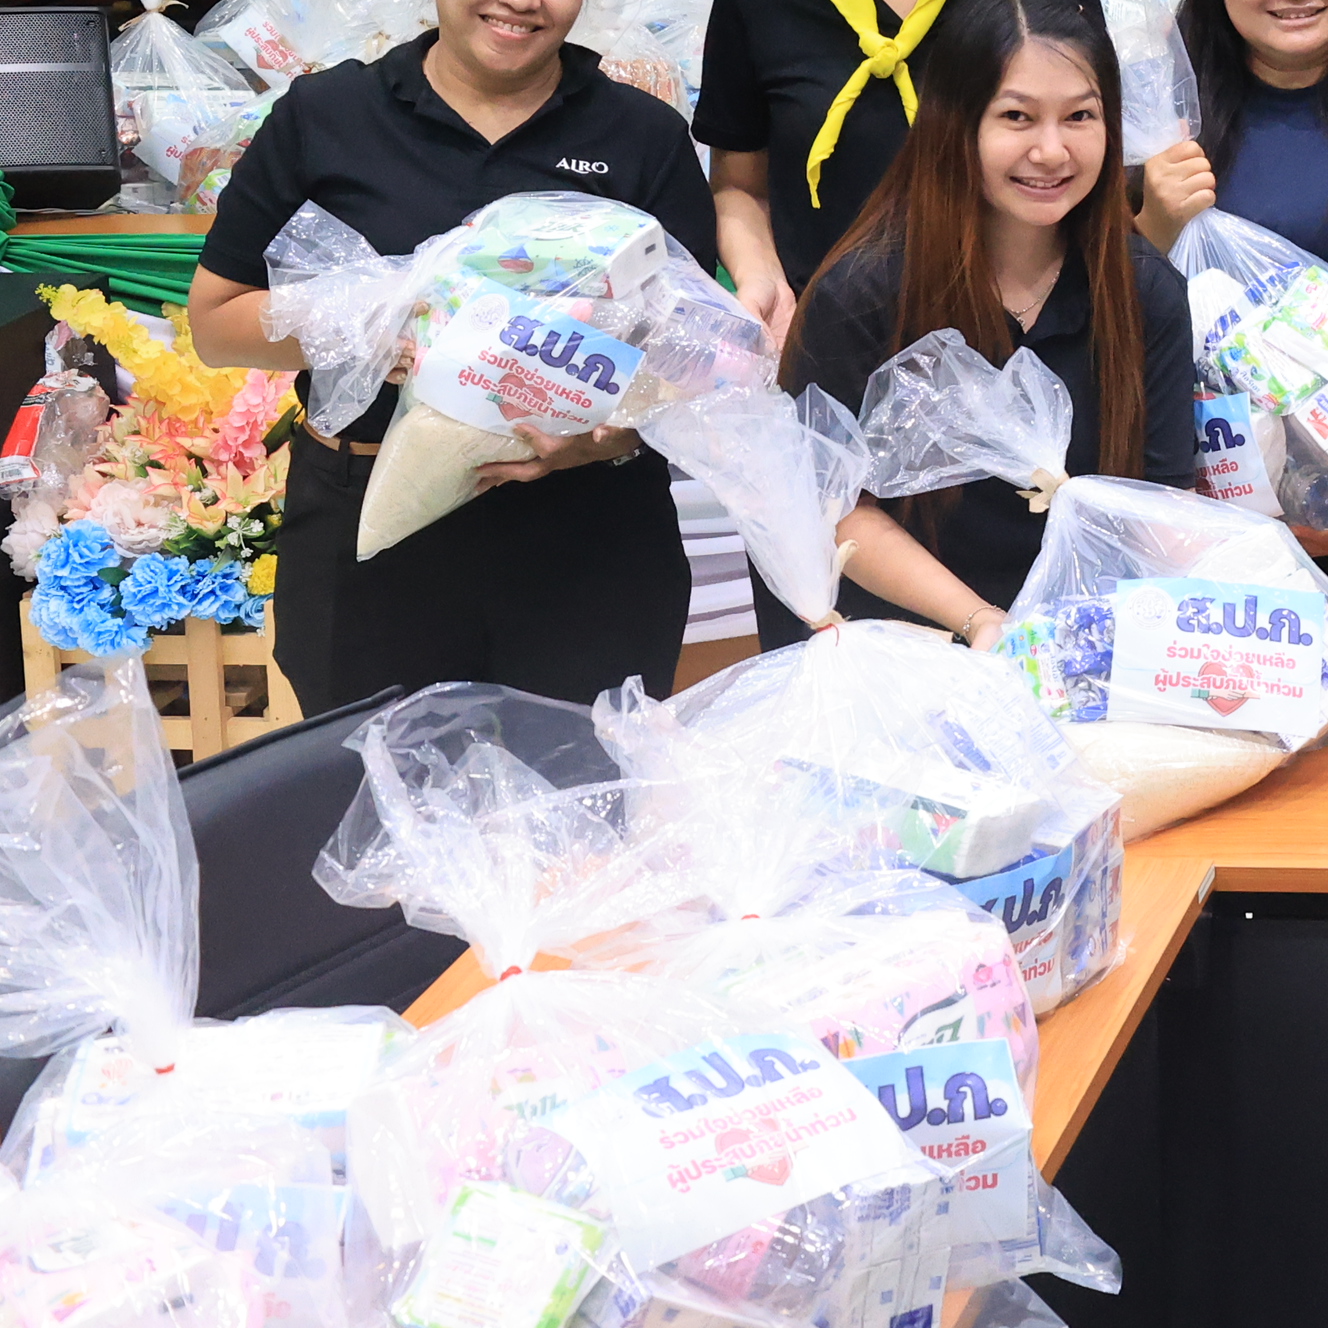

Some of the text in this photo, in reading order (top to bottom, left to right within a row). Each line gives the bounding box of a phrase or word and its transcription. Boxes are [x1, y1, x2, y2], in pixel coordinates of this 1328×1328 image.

[556, 157, 609, 174] ALRO
[478, 348, 593, 409] ร่วมใจช่วยเหลือ
[499, 314, 620, 395] ส.ป.ก.
[458, 367, 590, 424] ผู้ประสบภัยน้ำท่วม
[1176, 595, 1313, 646] ส.ป.ก.
[1166, 641, 1296, 670] ร่วมใจช่วยเหลือ
[1154, 671, 1304, 700] ผู้ประสบภัยน้ำท่วม
[636, 1046, 821, 1118] ส.ป.ก.
[659, 1084, 823, 1150] ร่วมใจช่วยเหลือ
[668, 1107, 857, 1194] ผู้ประสบภัยน้ำท่วม
